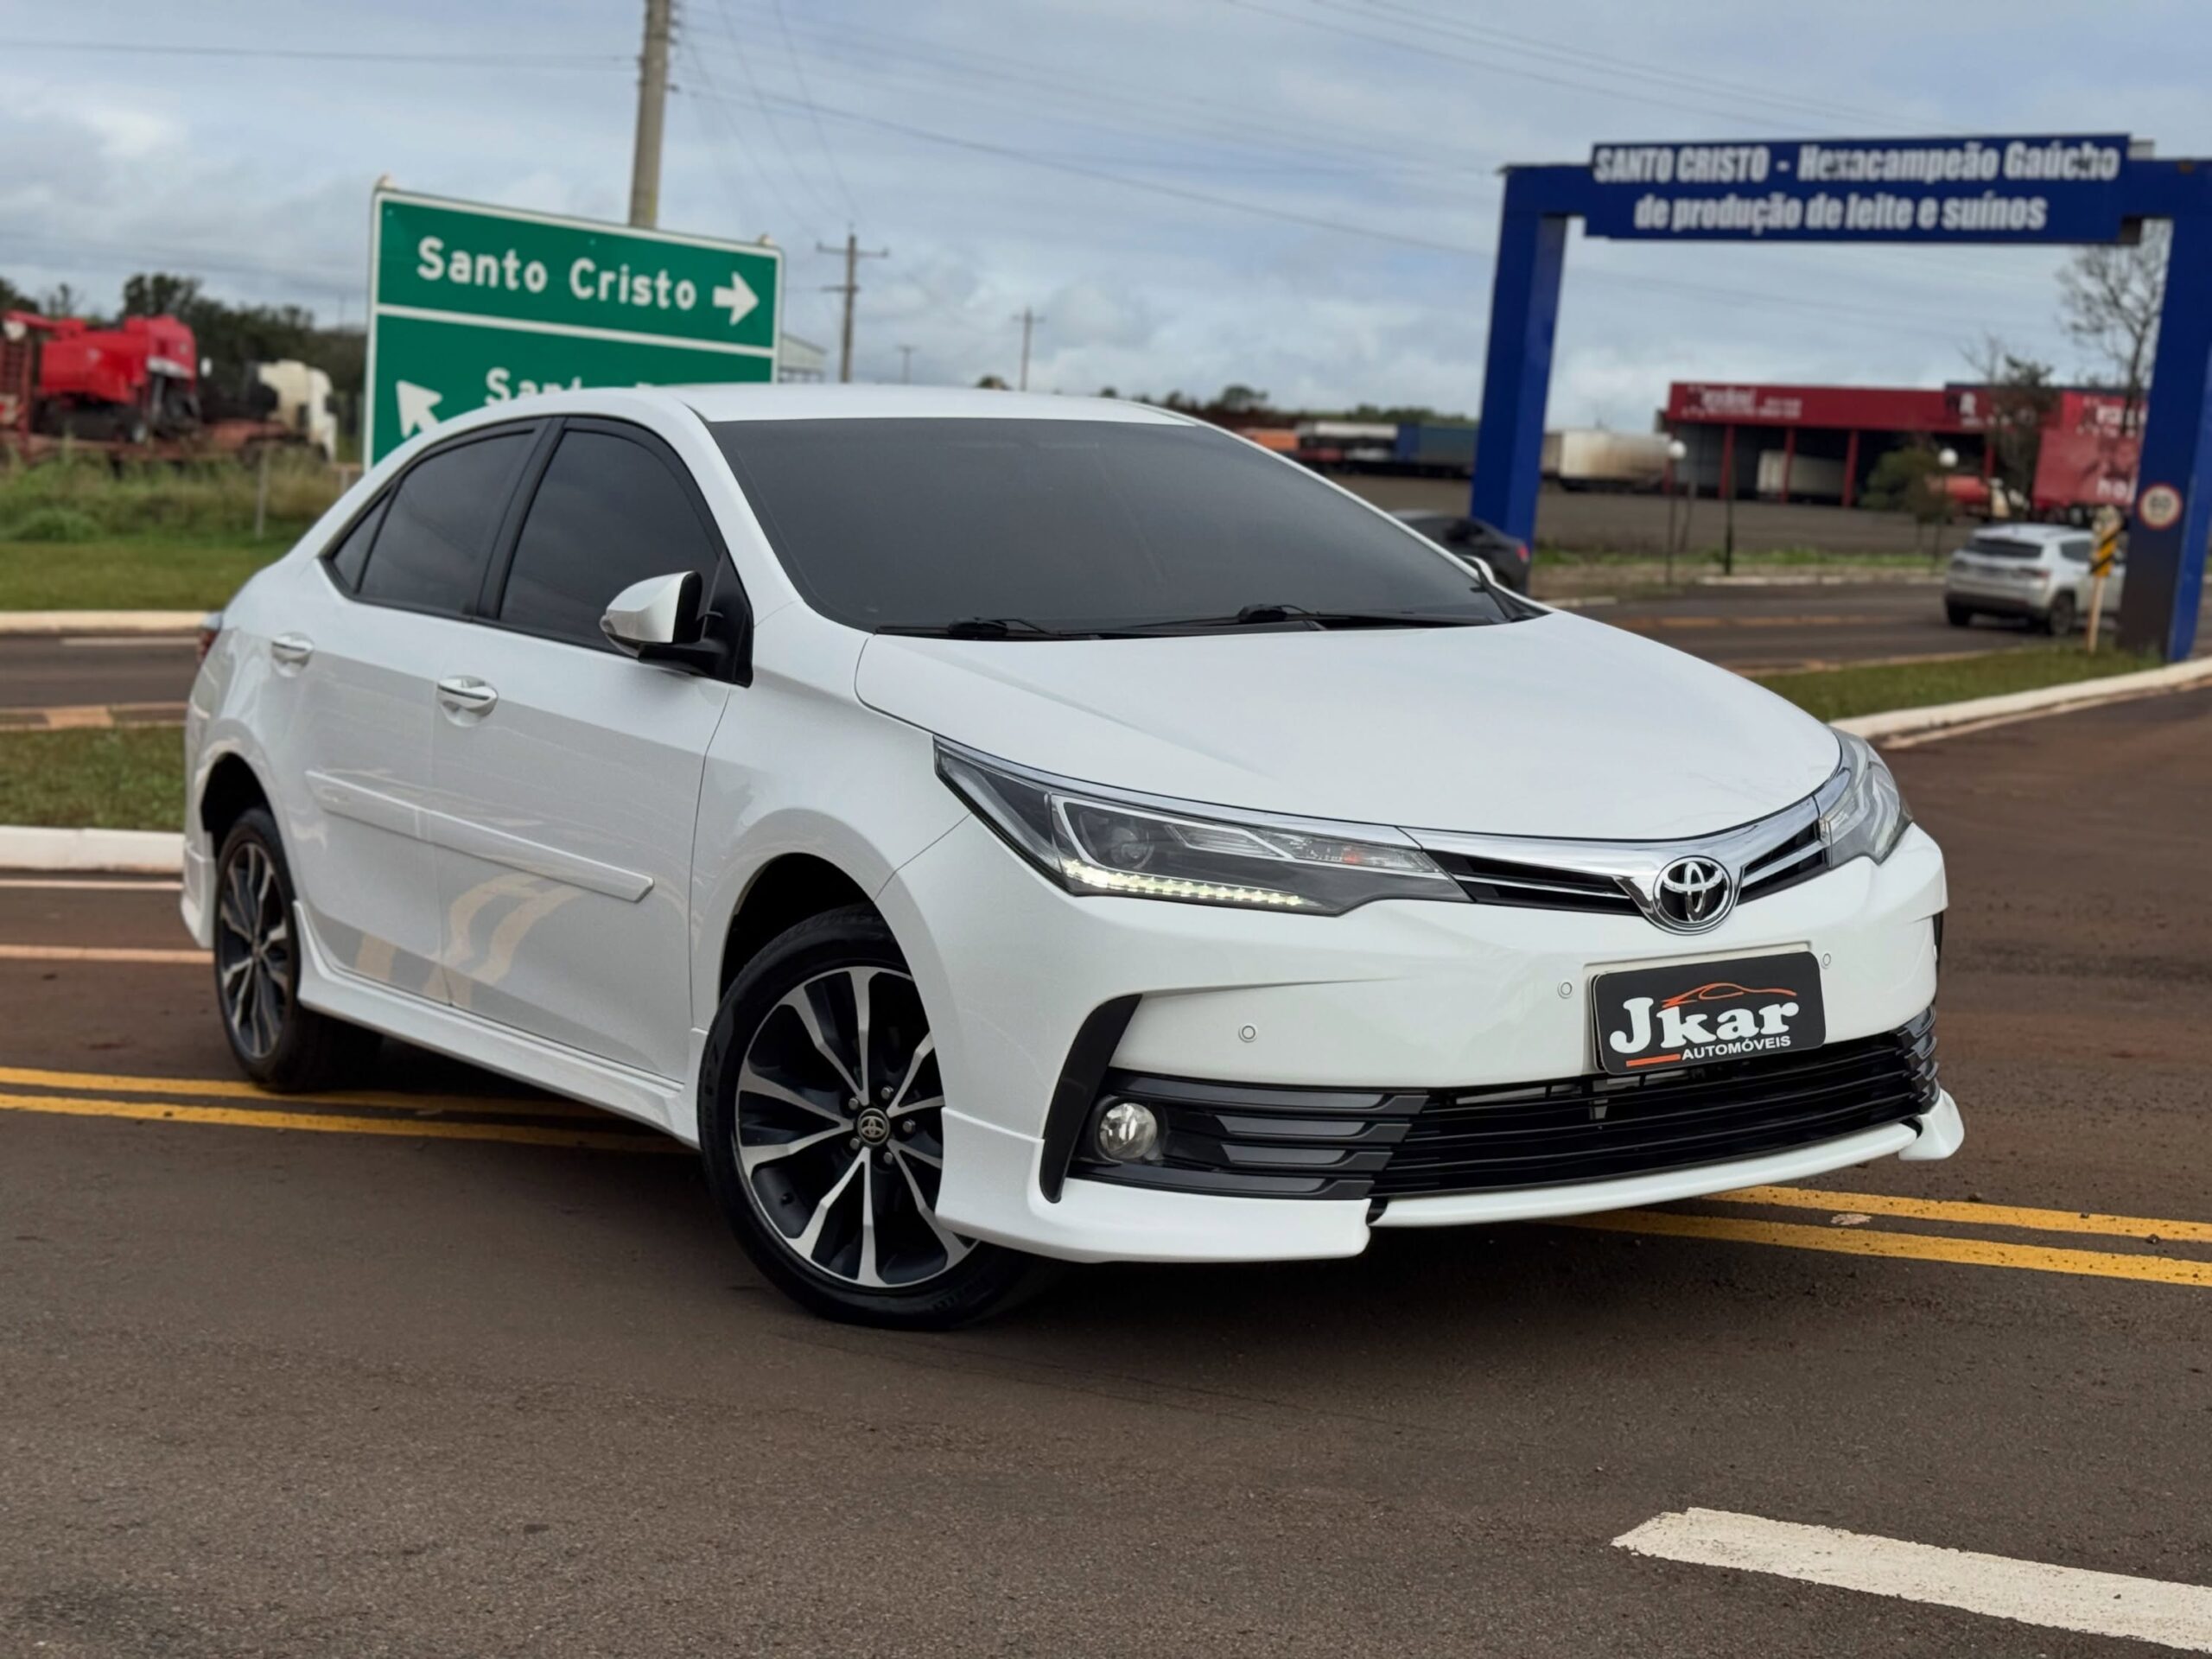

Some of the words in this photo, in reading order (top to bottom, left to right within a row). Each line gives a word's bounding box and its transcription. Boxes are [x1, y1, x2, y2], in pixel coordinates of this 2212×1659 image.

[1593, 146, 1675, 183] SANTO
[1676, 144, 1770, 183] CRISTO
[1796, 142, 2000, 184] Hexacampeão
[2002, 140, 2121, 181] Gaúcho
[1633, 193, 1670, 230] de
[1670, 192, 1803, 236] produção
[1804, 192, 1844, 230] de
[1844, 191, 1915, 230] leite
[1916, 196, 1939, 230] e
[1941, 189, 2049, 231] suínos
[417, 236, 548, 294] Santo
[569, 257, 696, 310] Cristo
[1609, 996, 1800, 1054] Jkar
[1681, 1035, 1792, 1061] AUTOMÓVEIS
